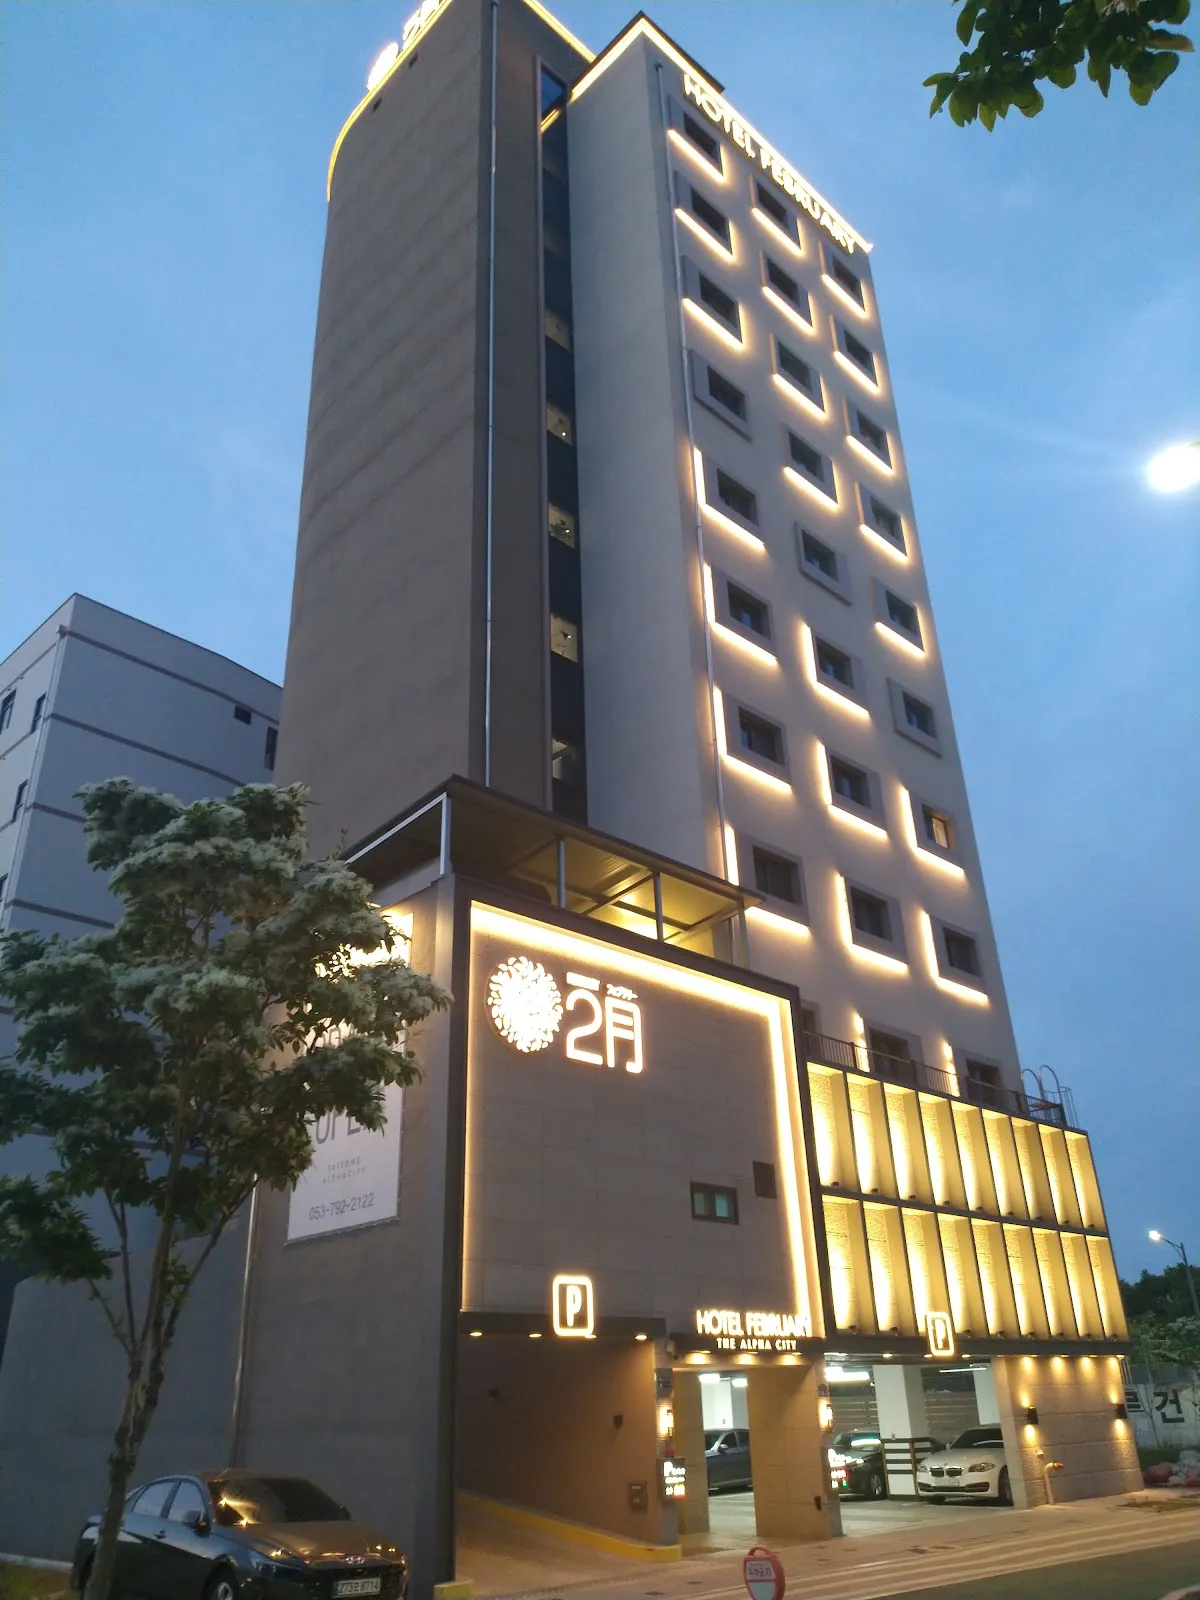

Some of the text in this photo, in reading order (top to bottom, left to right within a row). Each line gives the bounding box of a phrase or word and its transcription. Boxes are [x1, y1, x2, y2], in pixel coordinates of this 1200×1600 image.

[309, 1192, 375, 1221] 053-792-2122
[696, 1309, 744, 1336] HOTEL
[716, 1337, 797, 1350] THE ALPHA CITY
